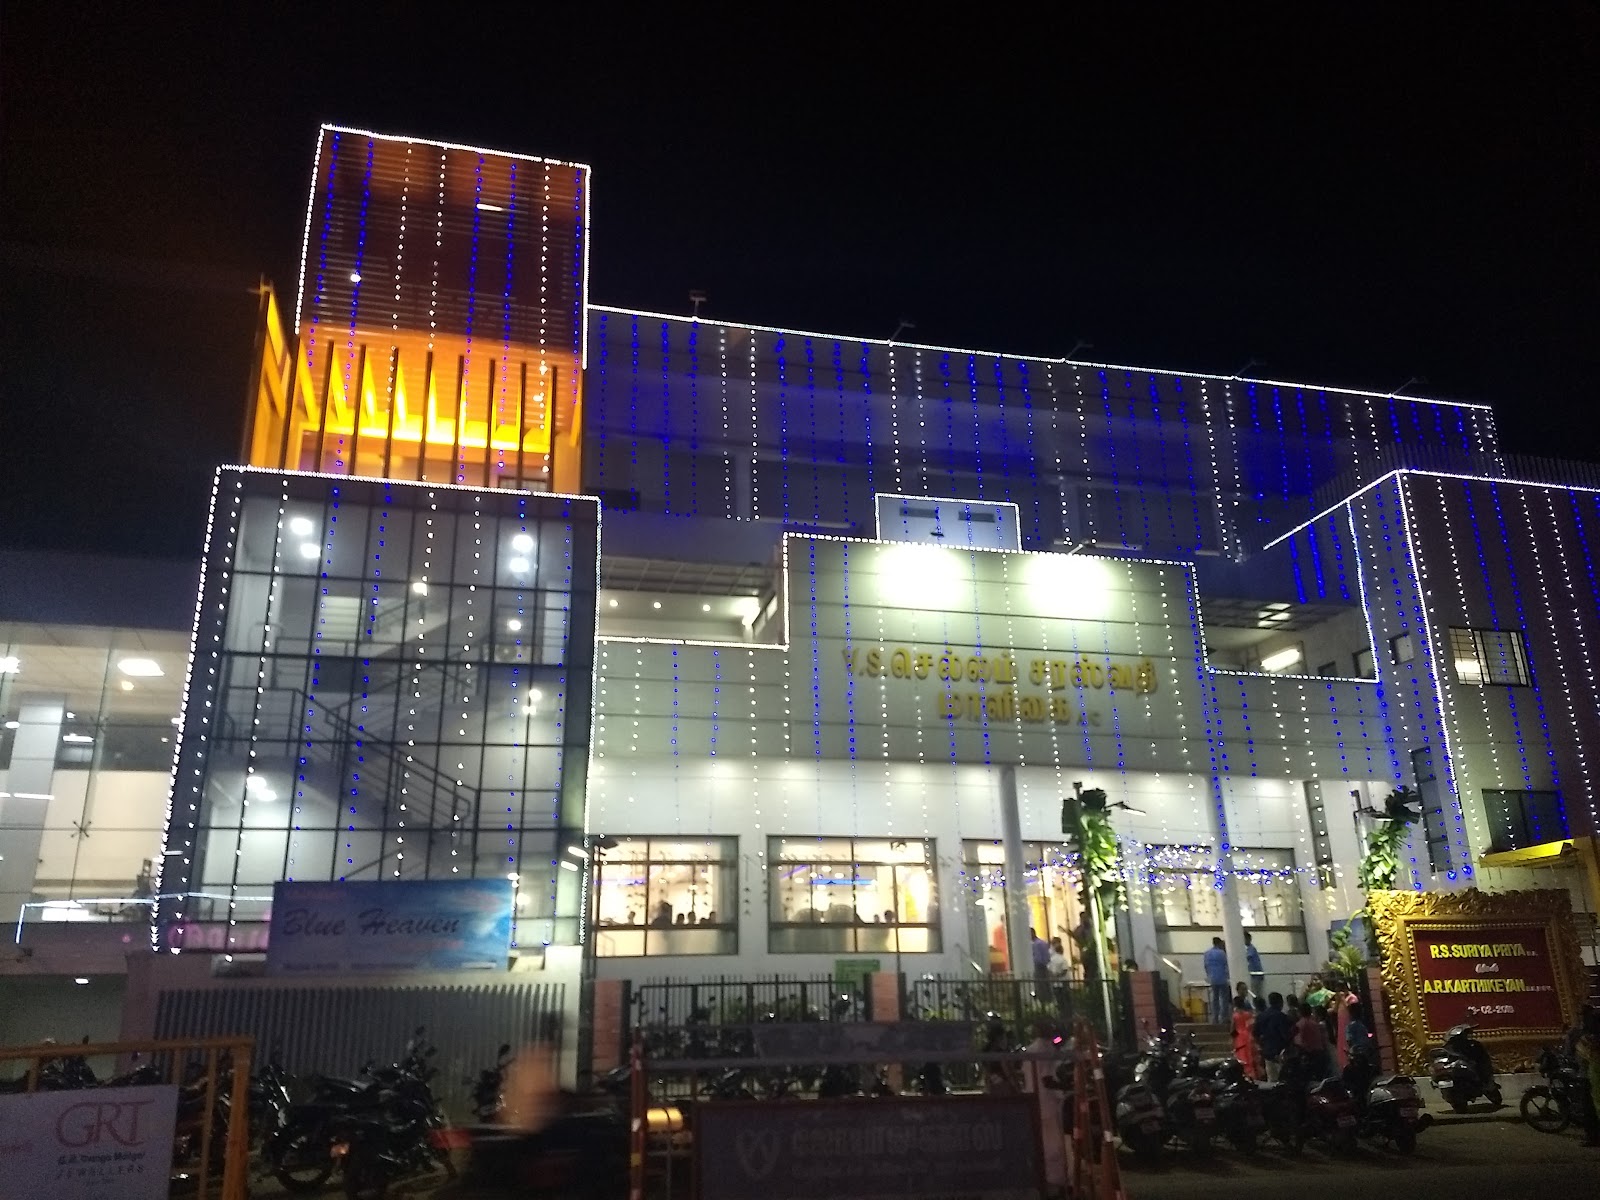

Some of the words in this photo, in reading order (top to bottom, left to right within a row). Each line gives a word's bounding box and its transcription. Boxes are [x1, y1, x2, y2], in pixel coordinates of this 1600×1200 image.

[282, 908, 346, 936] Blue
[358, 908, 460, 936] Heaven
[57, 1100, 154, 1147] GRT
